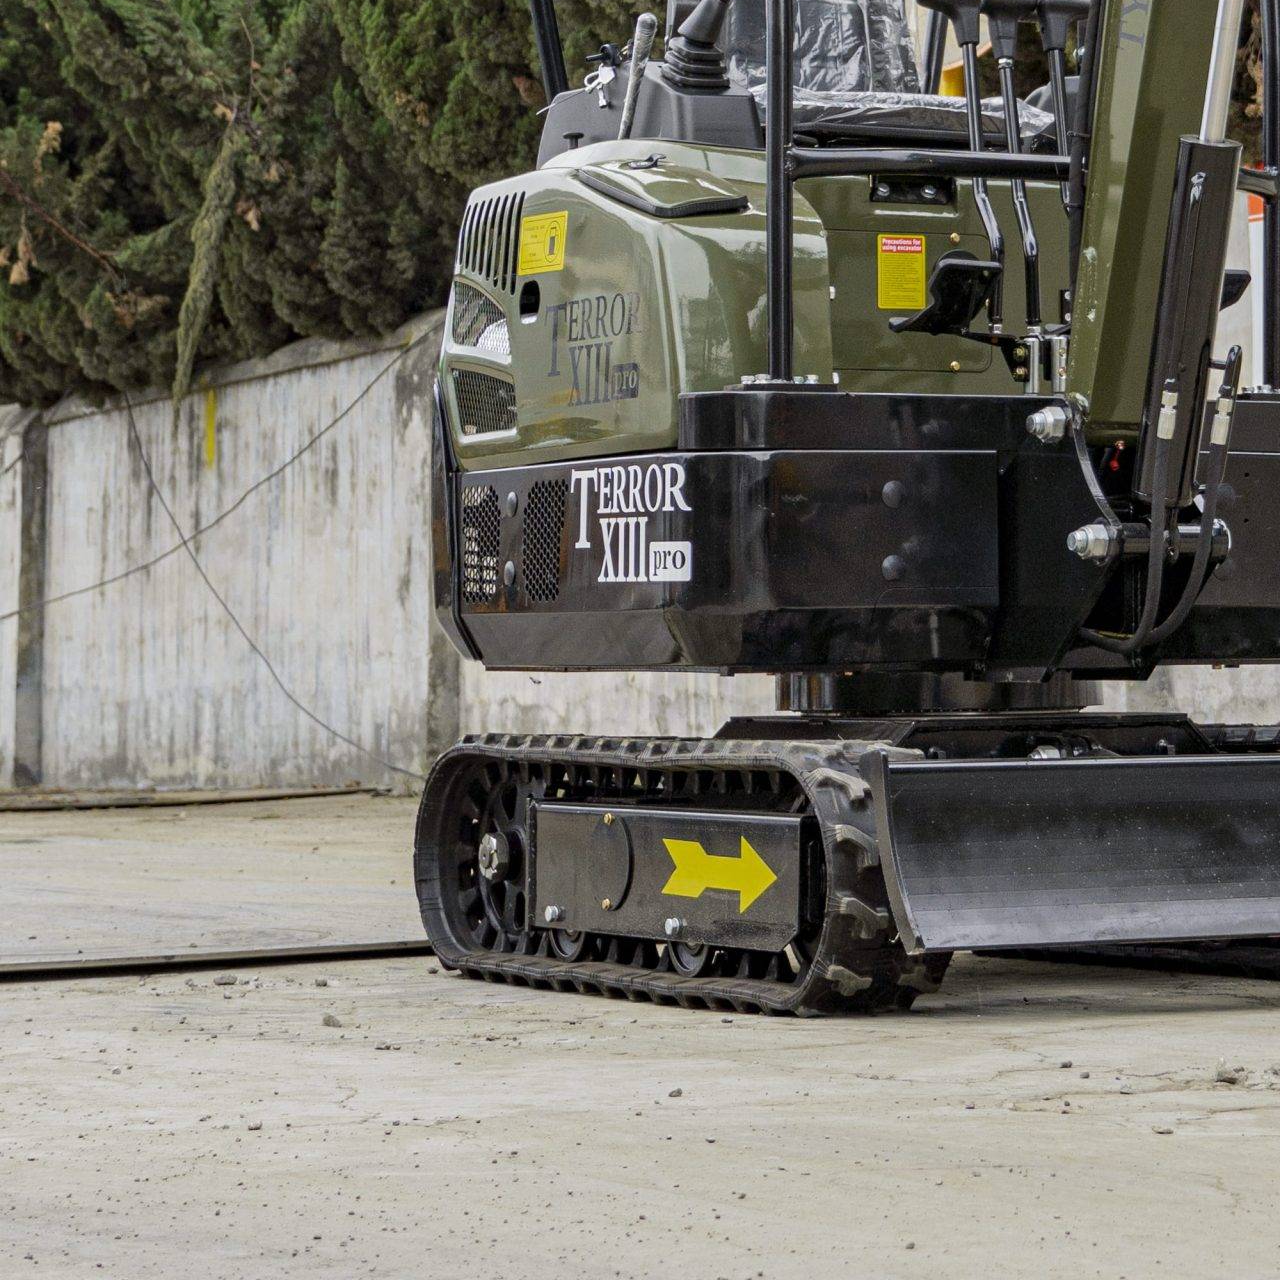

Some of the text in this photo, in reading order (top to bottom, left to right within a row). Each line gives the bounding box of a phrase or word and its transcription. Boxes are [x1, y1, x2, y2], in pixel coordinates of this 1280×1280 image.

[544, 293, 642, 377] TERROR
[568, 341, 638, 407] XIII pro
[570, 463, 692, 549] TERROR
[597, 516, 686, 582] XIII pro
